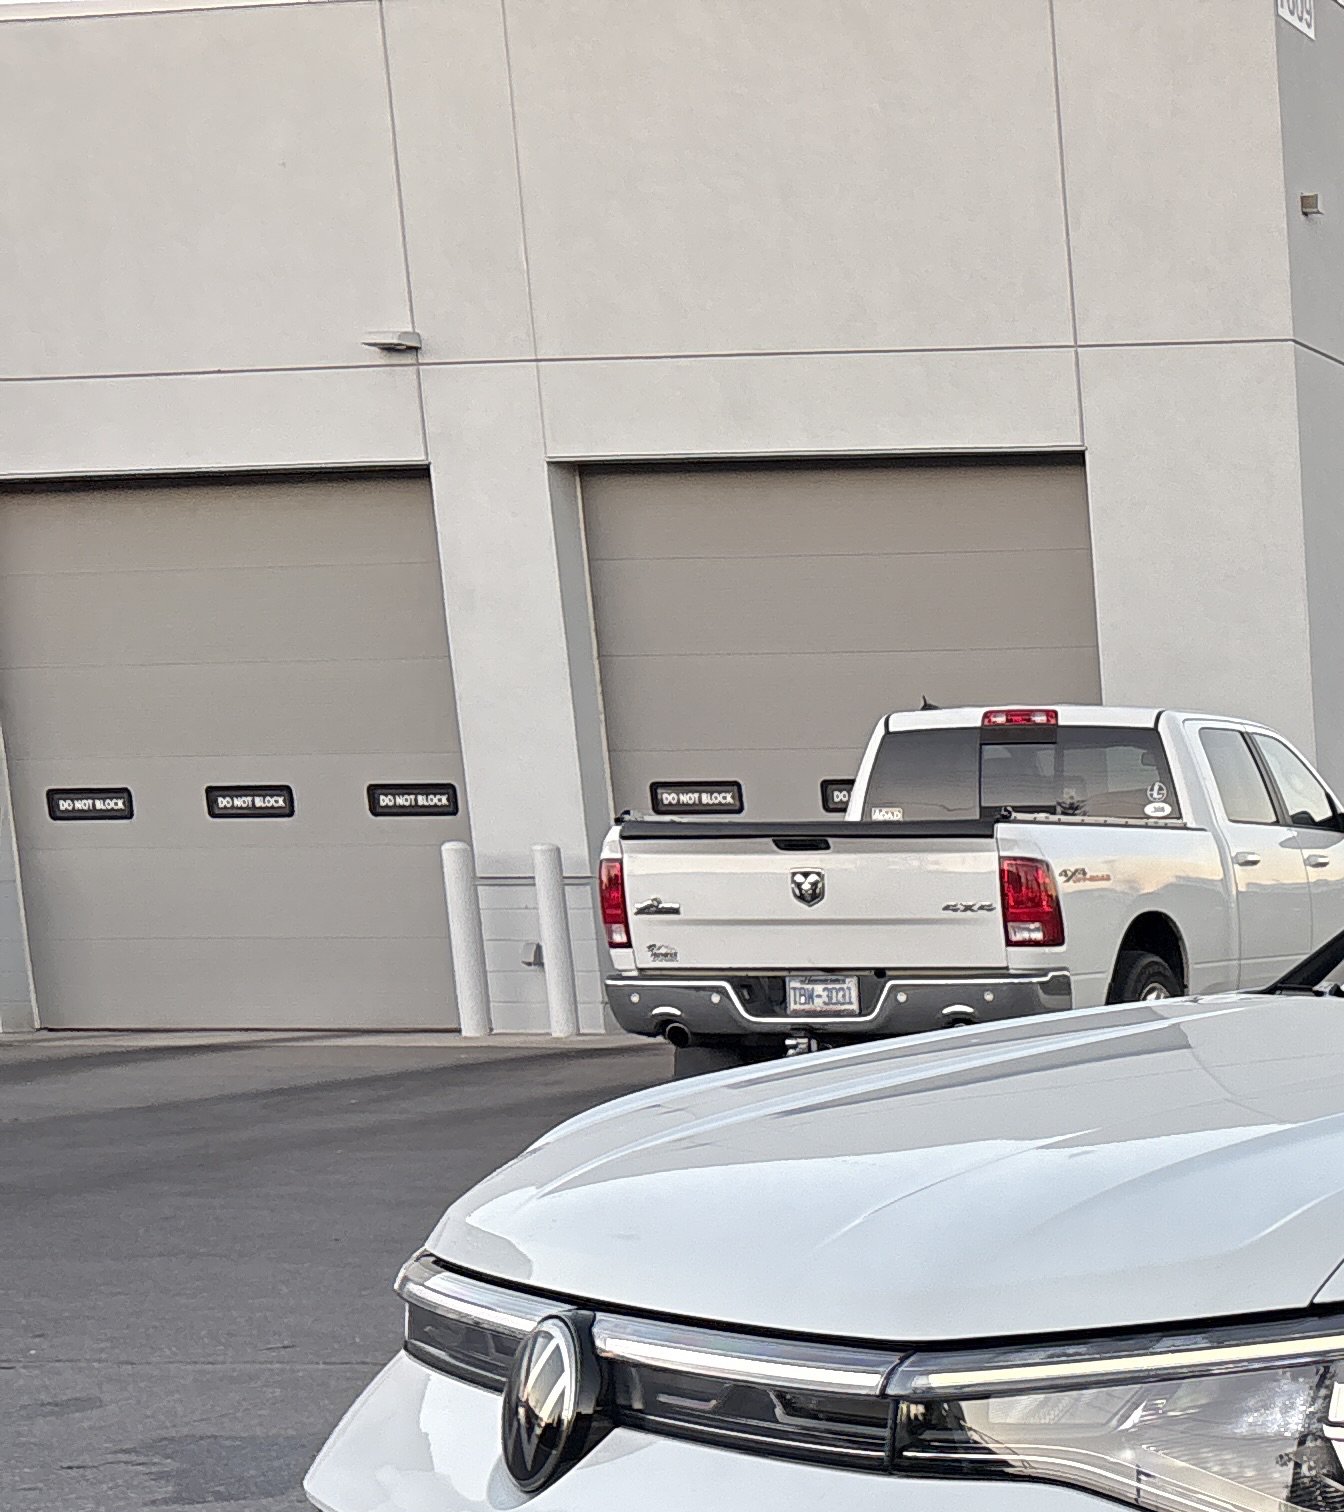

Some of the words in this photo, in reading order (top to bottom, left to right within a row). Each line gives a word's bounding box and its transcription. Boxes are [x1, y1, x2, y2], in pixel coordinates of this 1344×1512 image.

[217, 796, 233, 808] DO
[233, 796, 253, 808] NOT
[254, 795, 286, 807] BLOCK
[379, 794, 395, 806] DO
[395, 794, 416, 806] NOT
[417, 794, 449, 806] BLOCK
[661, 793, 678, 805] DO
[679, 792, 700, 805] NOT
[701, 792, 735, 805] BLOCK
[833, 790, 849, 802] DO
[59, 799, 73, 811] DO
[74, 799, 94, 811] NOT
[94, 798, 126, 810] BLOCK
